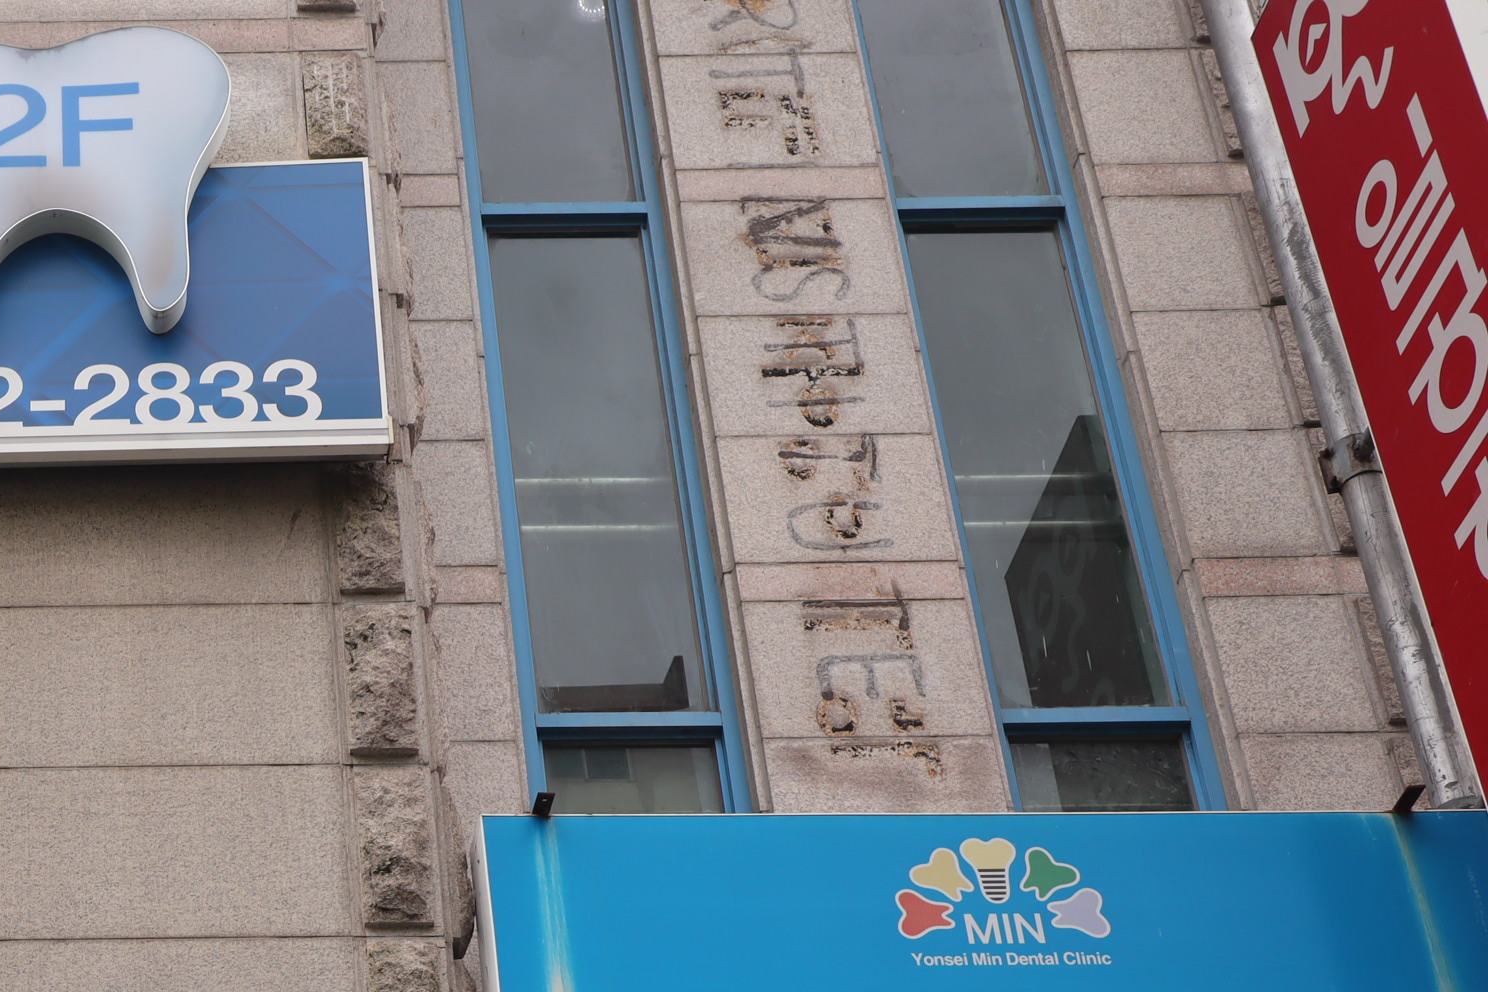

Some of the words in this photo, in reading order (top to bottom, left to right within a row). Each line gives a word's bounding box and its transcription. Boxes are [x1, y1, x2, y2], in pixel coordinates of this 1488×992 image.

[963, 913, 1047, 944] MIN
[911, 952, 969, 966] Yonsei
[972, 952, 1003, 966] Min
[1006, 952, 1060, 966] Dental
[1063, 951, 1112, 965] Clinic
